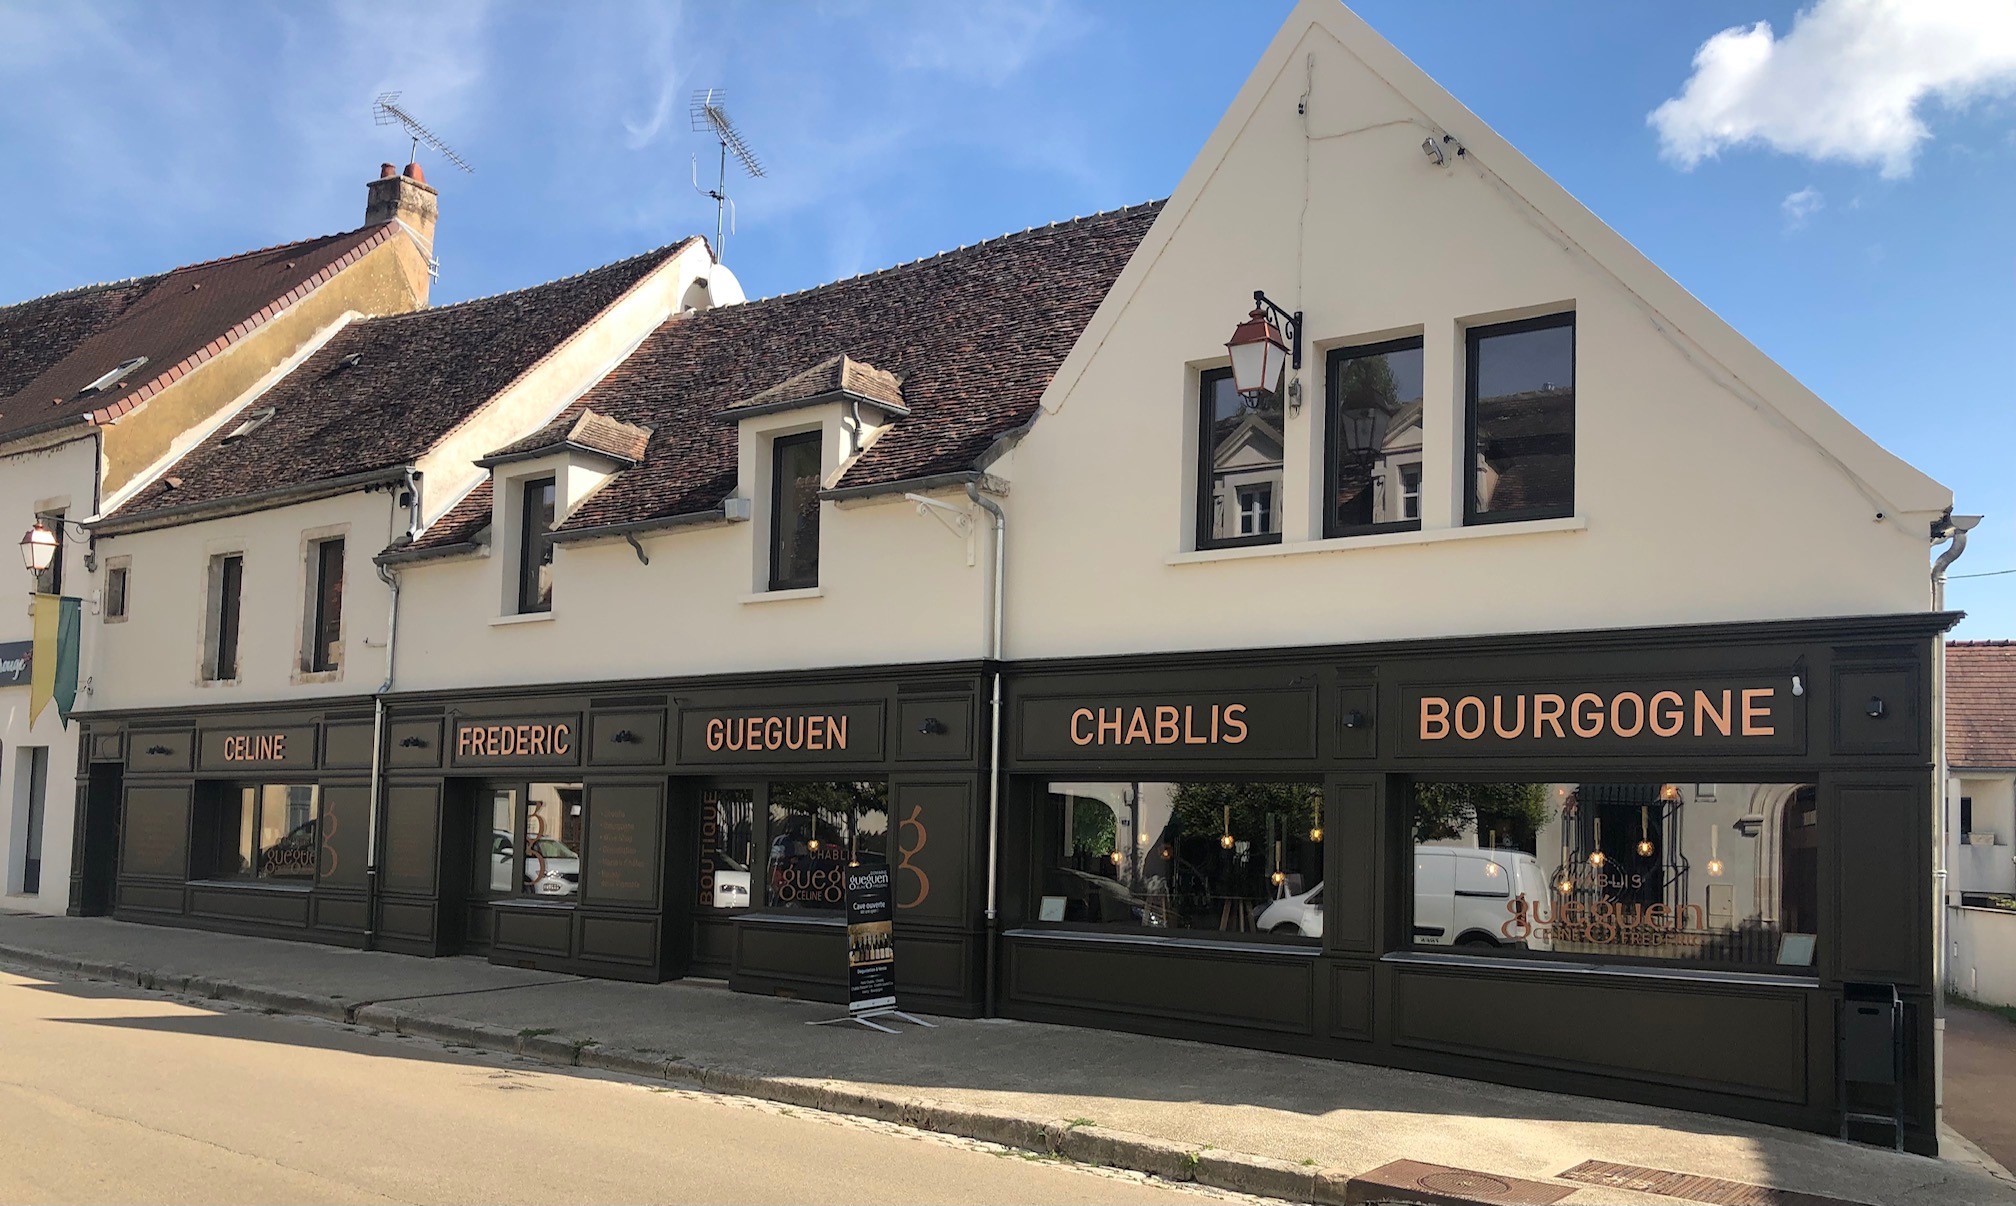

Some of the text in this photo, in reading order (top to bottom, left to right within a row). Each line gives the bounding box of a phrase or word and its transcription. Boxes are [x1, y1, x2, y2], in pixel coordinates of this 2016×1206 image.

[1070, 703, 1248, 746] CHABLIS
[1419, 688, 1775, 740] BOURGOGNE
[224, 735, 285, 761] CELINE
[459, 724, 570, 756] FREDERIC
[706, 715, 848, 752] GUEGUEN
[699, 790, 717, 906] BOUTIQUE
[778, 864, 847, 903] gueg
[796, 890, 822, 901] CELINE
[849, 873, 889, 891] gueguen
[853, 902, 865, 911] Cave
[1501, 892, 1704, 944] gueguen
